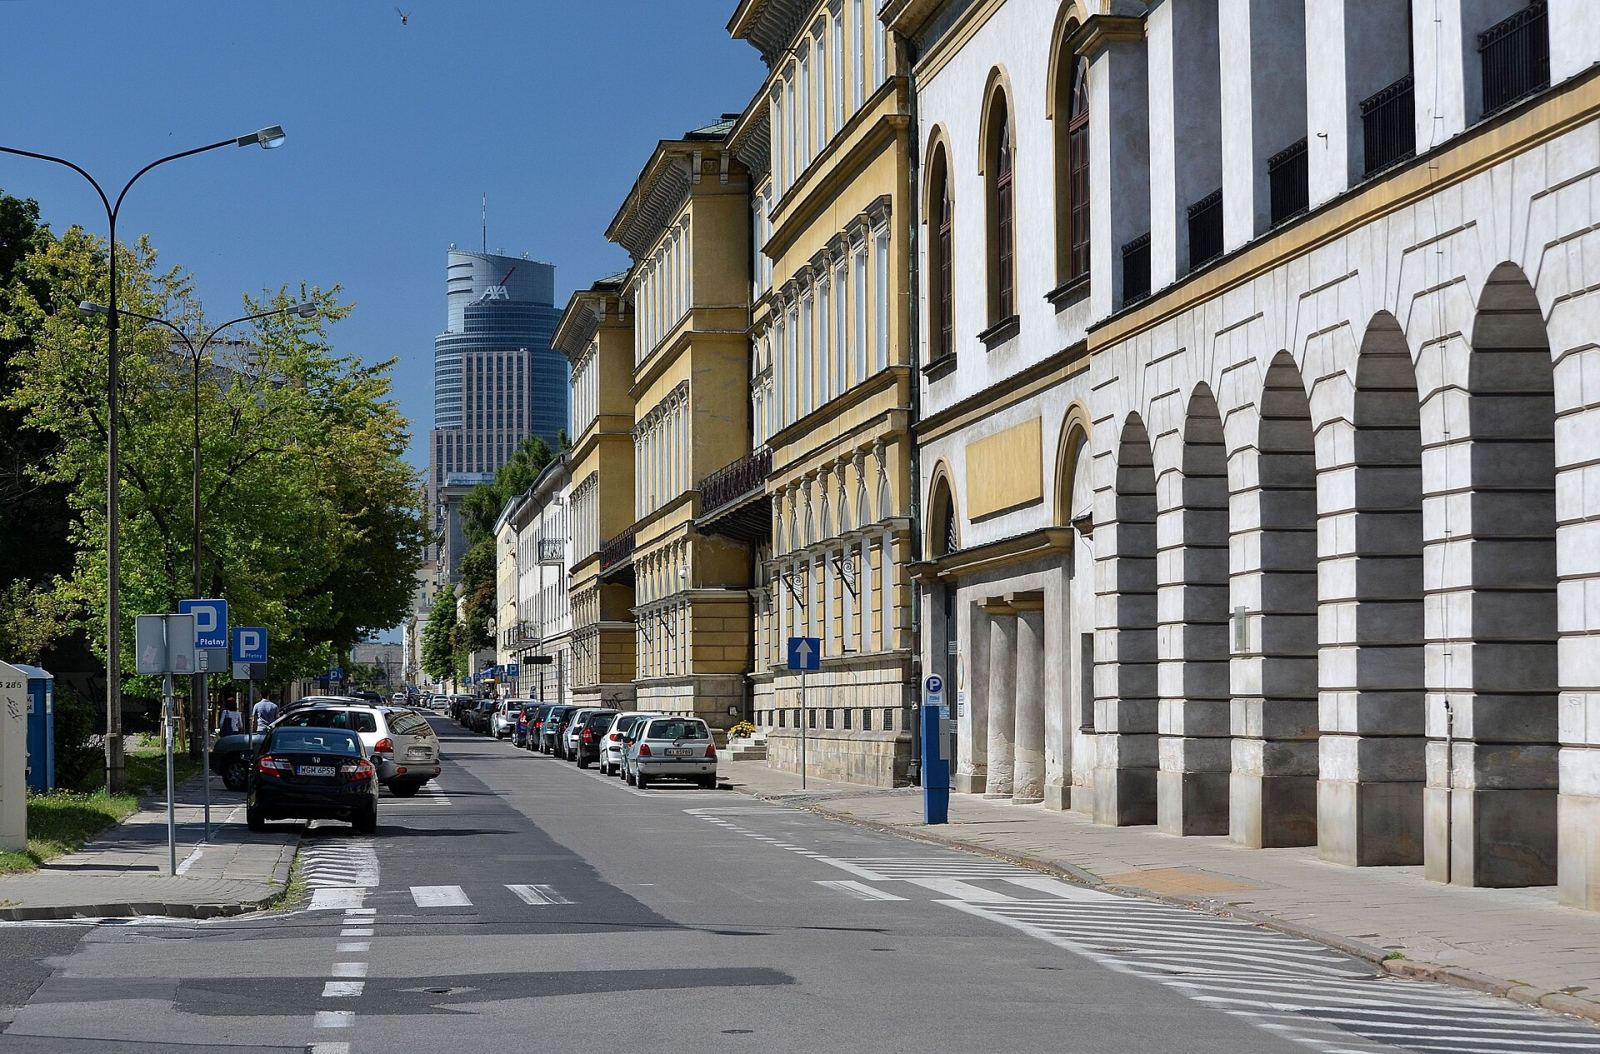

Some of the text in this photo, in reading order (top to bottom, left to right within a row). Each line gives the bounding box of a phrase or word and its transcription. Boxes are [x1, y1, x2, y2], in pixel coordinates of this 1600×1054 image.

[480, 285, 510, 300] AXA
[190, 605, 217, 643] P
[200, 638, 226, 647] Płatny
[240, 631, 260, 658] P
[330, 670, 338, 680] P
[509, 664, 517, 675] P
[929, 678, 941, 690] P
